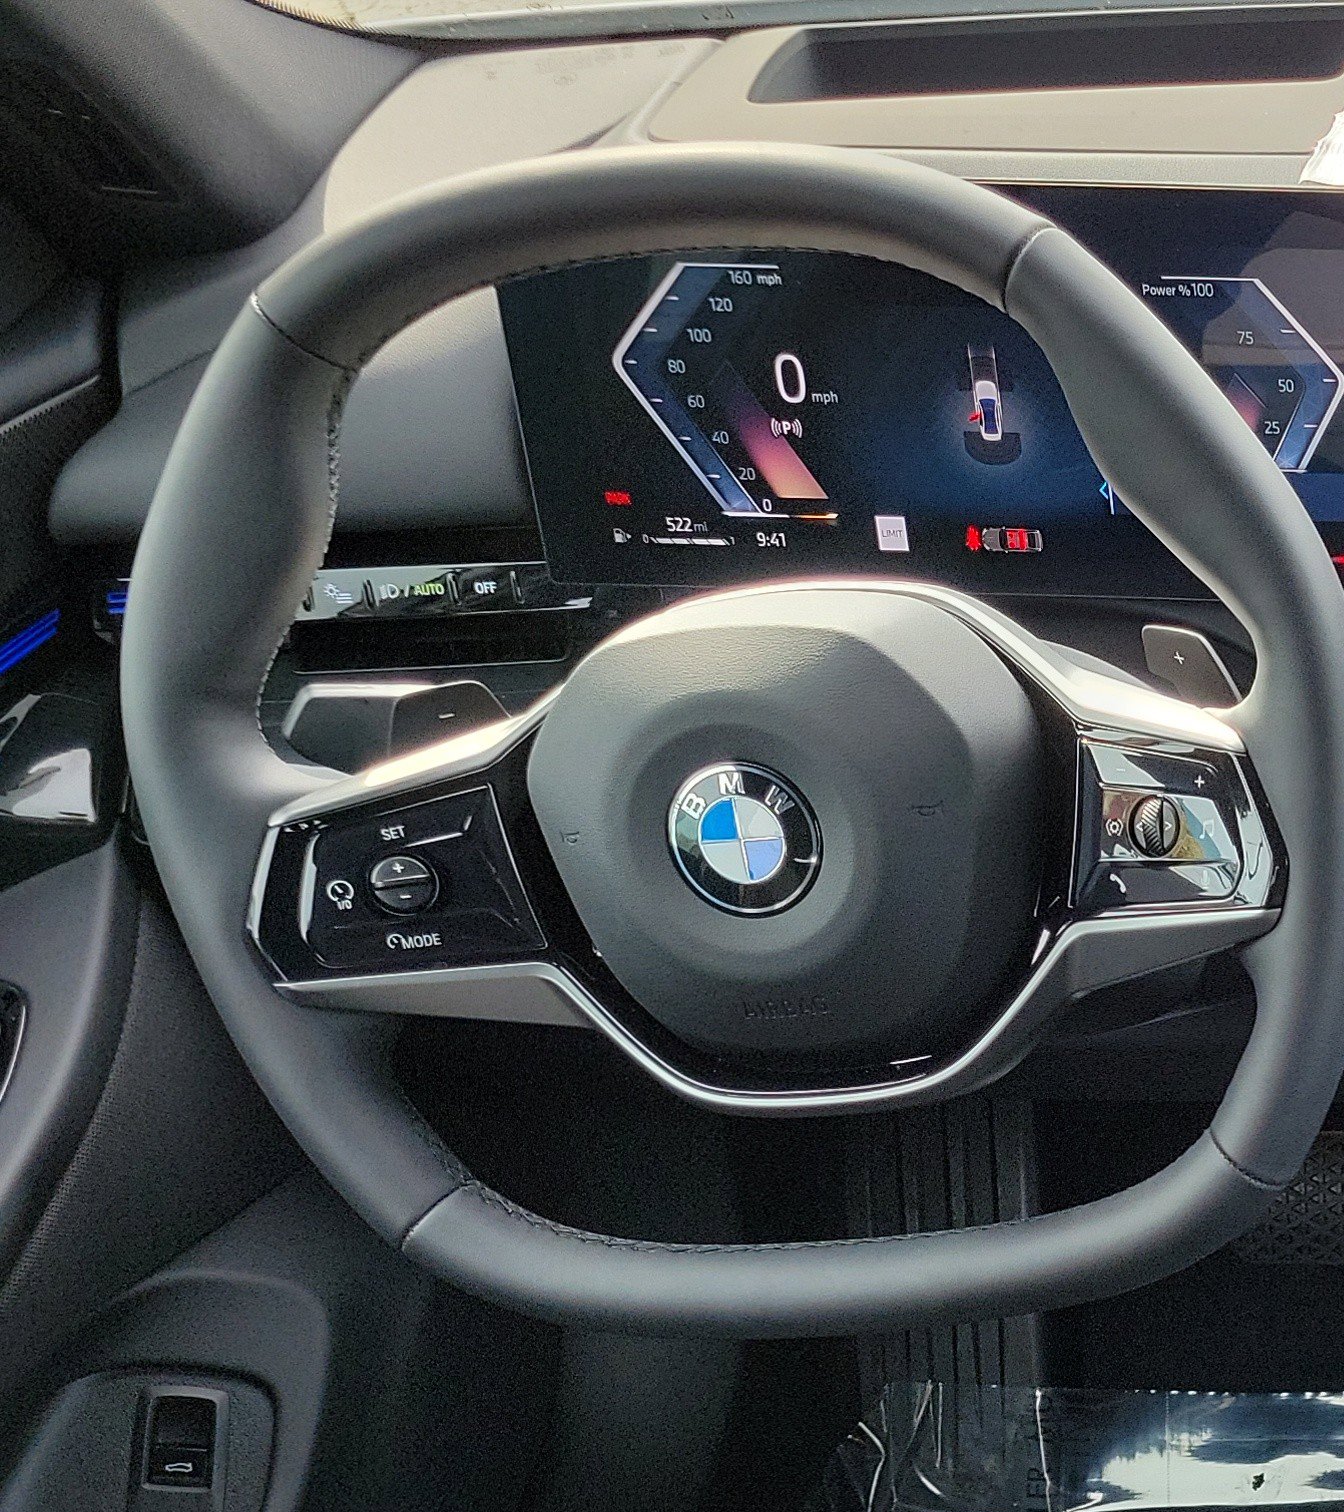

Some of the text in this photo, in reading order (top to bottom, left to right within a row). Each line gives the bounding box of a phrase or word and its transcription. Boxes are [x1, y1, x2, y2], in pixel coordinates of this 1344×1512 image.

[728, 270, 783, 287] 160 mph
[1142, 283, 1176, 297] Power
[709, 297, 733, 313] 120
[687, 327, 712, 344] 100
[1237, 331, 1254, 345] 75
[668, 358, 686, 374] 80
[774, 352, 839, 406] 0 mph
[1278, 379, 1294, 393] 50
[687, 394, 705, 409] 60
[1264, 420, 1281, 435] 25
[712, 430, 729, 445] 40
[739, 466, 756, 481] 20
[763, 499, 773, 513] 0
[666, 516, 693, 533] 522
[756, 532, 787, 548] 9:41
[881, 529, 904, 538] LIMIT
[413, 583, 445, 596] AUTO
[474, 582, 498, 595] OFF
[680, 771, 796, 821] BMW
[380, 826, 406, 841] SET
[402, 933, 443, 949] MODE
